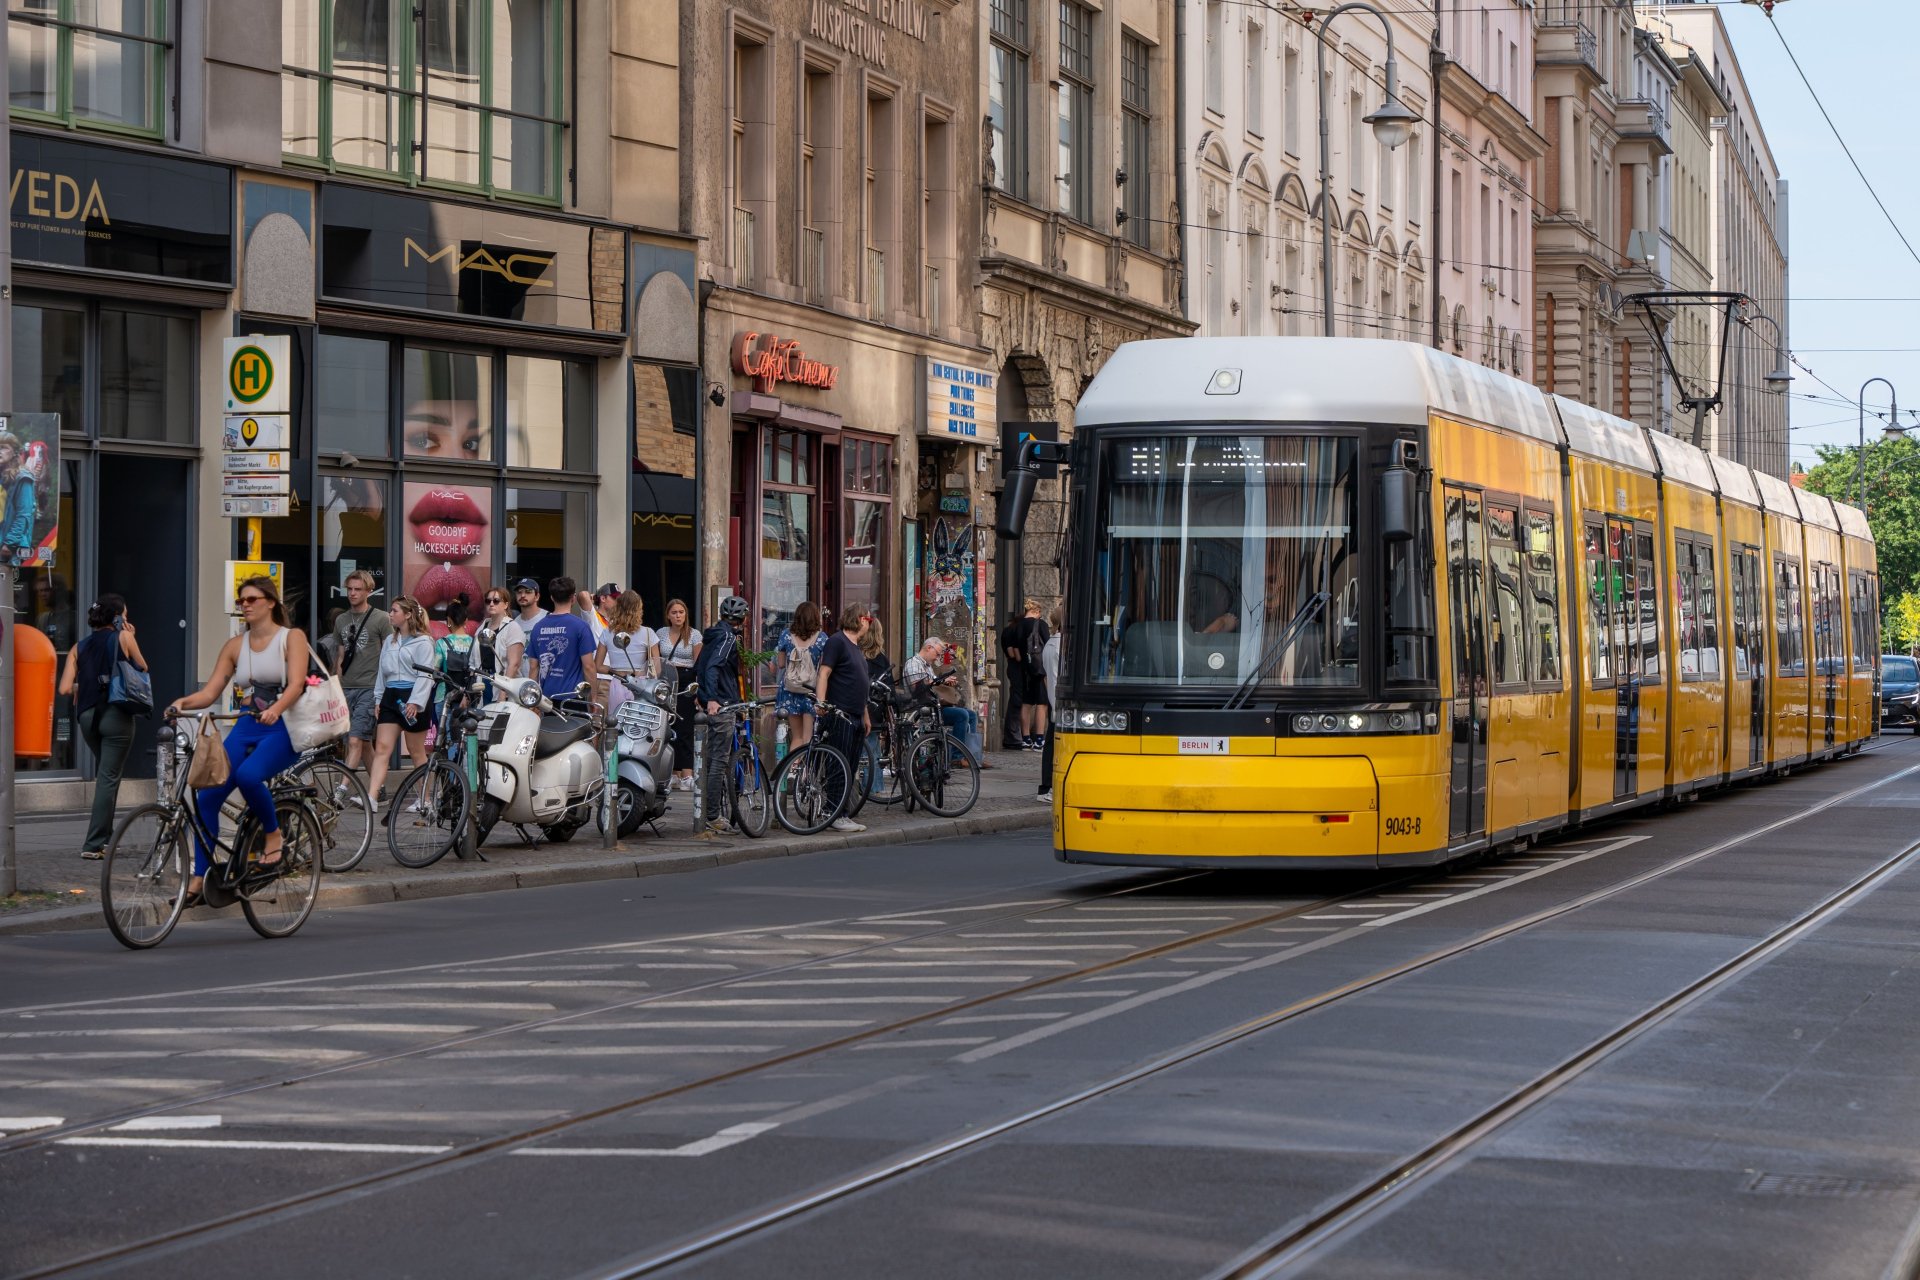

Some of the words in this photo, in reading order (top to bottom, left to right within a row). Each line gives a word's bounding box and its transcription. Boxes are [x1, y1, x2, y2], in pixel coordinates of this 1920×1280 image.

[810, 0, 886, 69] AUSRÜSTUNG
[27, 223, 40, 231] PURE
[41, 225, 60, 233] FLOWER
[61, 227, 71, 235] AND
[71, 228, 87, 236] PLANT
[88, 231, 111, 239] ESSENCES
[745, 333, 786, 393] Café
[786, 341, 839, 390] Cinema
[240, 359, 260, 390] H
[428, 525, 467, 538] GOODBYE
[414, 542, 459, 554] HACKESCHE
[460, 541, 481, 555] HÖFE
[1181, 741, 1209, 749] BERLIN
[1385, 817, 1422, 836] 9043-B
